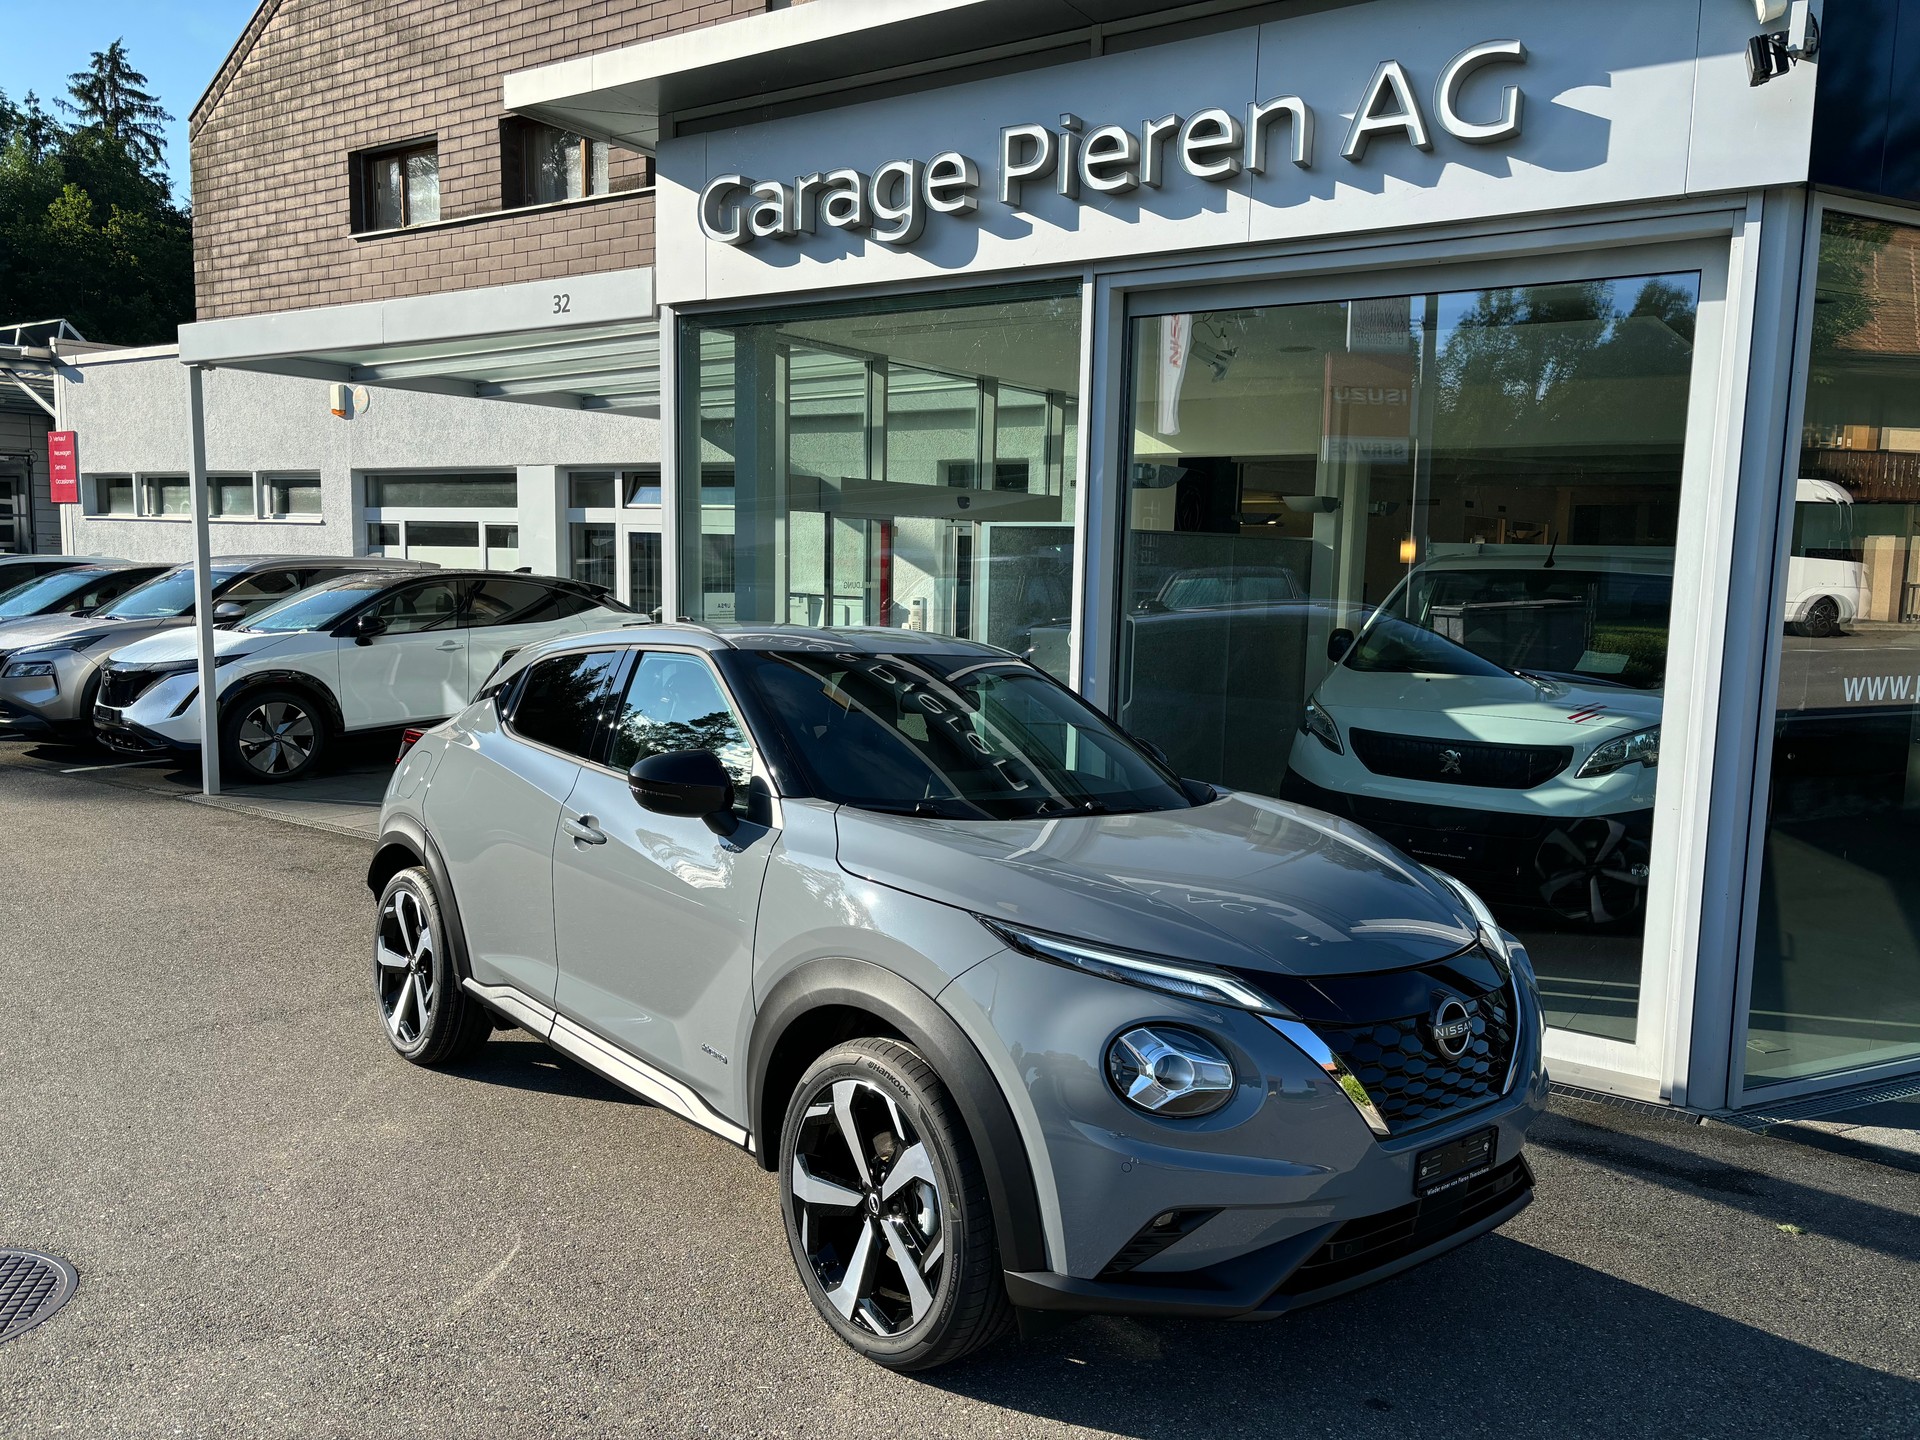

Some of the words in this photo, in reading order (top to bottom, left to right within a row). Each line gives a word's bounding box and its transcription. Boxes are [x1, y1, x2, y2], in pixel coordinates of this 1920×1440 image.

[698, 150, 979, 246] Garage
[999, 94, 1314, 206] Pieren
[1340, 39, 1527, 161] AG
[553, 294, 570, 314] 32
[1435, 1020, 1473, 1037] NISSAN
